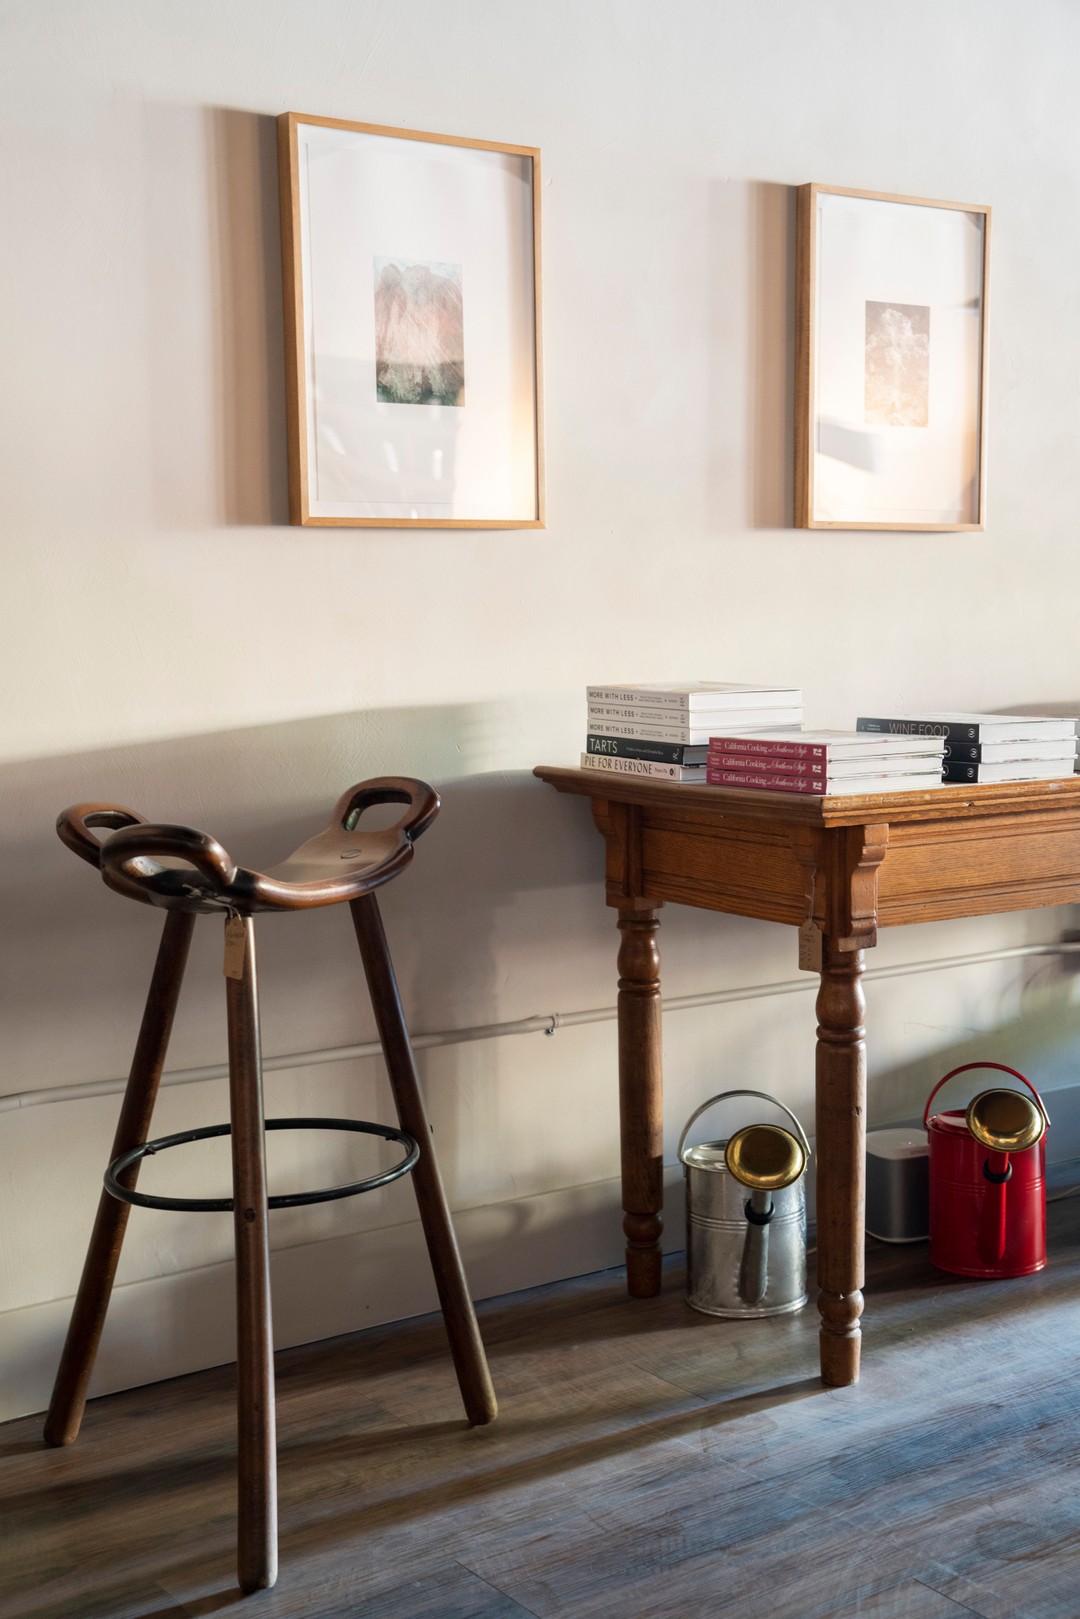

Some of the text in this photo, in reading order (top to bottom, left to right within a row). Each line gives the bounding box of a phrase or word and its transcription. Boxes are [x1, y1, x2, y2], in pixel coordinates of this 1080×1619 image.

[589, 691, 603, 699] MORE
[590, 707, 604, 715] MORE
[621, 710, 635, 718] LESS
[605, 725, 620, 733] WITH
[621, 727, 635, 735] LESS
[918, 724, 950, 737] FOOD
[590, 738, 618, 754] TARTS
[724, 741, 747, 751] California
[747, 743, 768, 755] Cooking
[585, 755, 595, 767] PIE
[598, 757, 612, 769] FOR
[614, 759, 653, 775] EVERYONE
[722, 757, 745, 767] California
[745, 759, 767, 771] Cooking
[723, 773, 746, 783] California
[746, 775, 767, 787] Cooking
